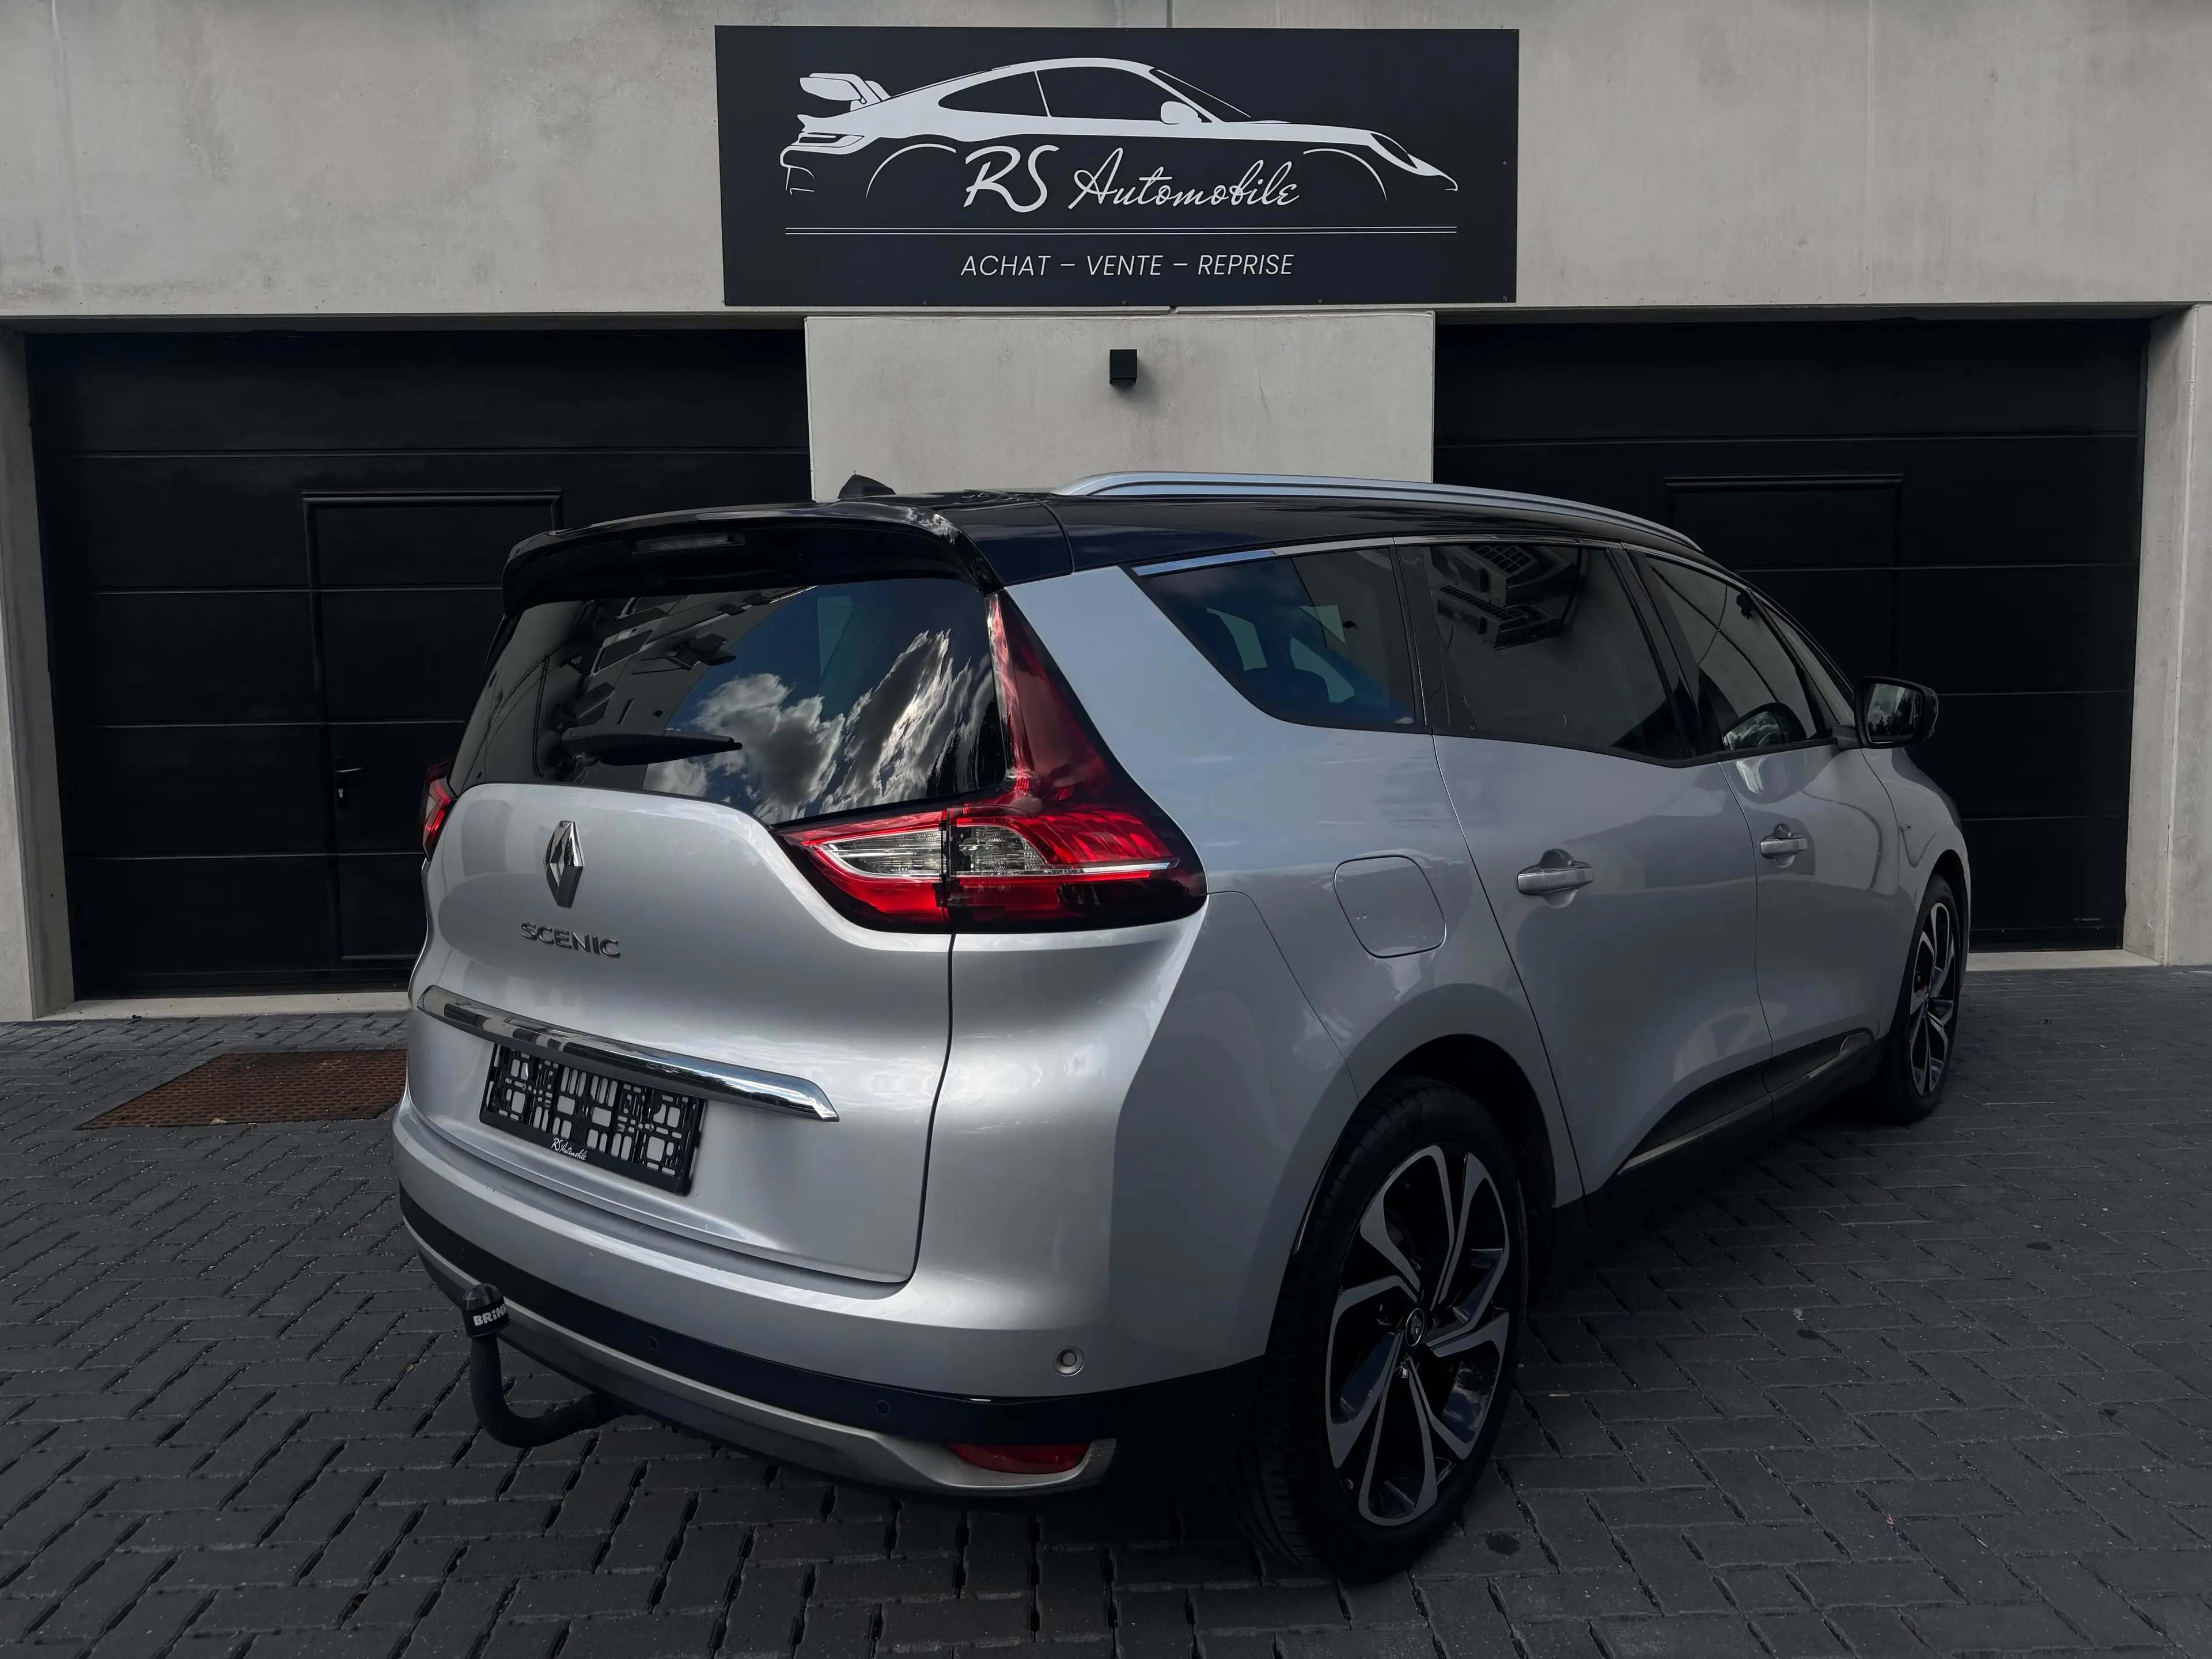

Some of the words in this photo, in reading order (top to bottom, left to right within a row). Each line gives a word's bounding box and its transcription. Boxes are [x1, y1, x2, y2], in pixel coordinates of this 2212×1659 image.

[963, 145, 1060, 213] RS
[1067, 147, 1300, 210] Automobile
[960, 255, 1051, 276] ACHAT
[1087, 255, 1164, 275] VENTE
[1198, 254, 1294, 275] REPRISE
[521, 922, 620, 958] SCENIC
[551, 1138, 563, 1151] RS
[559, 1141, 588, 1161] Automobile
